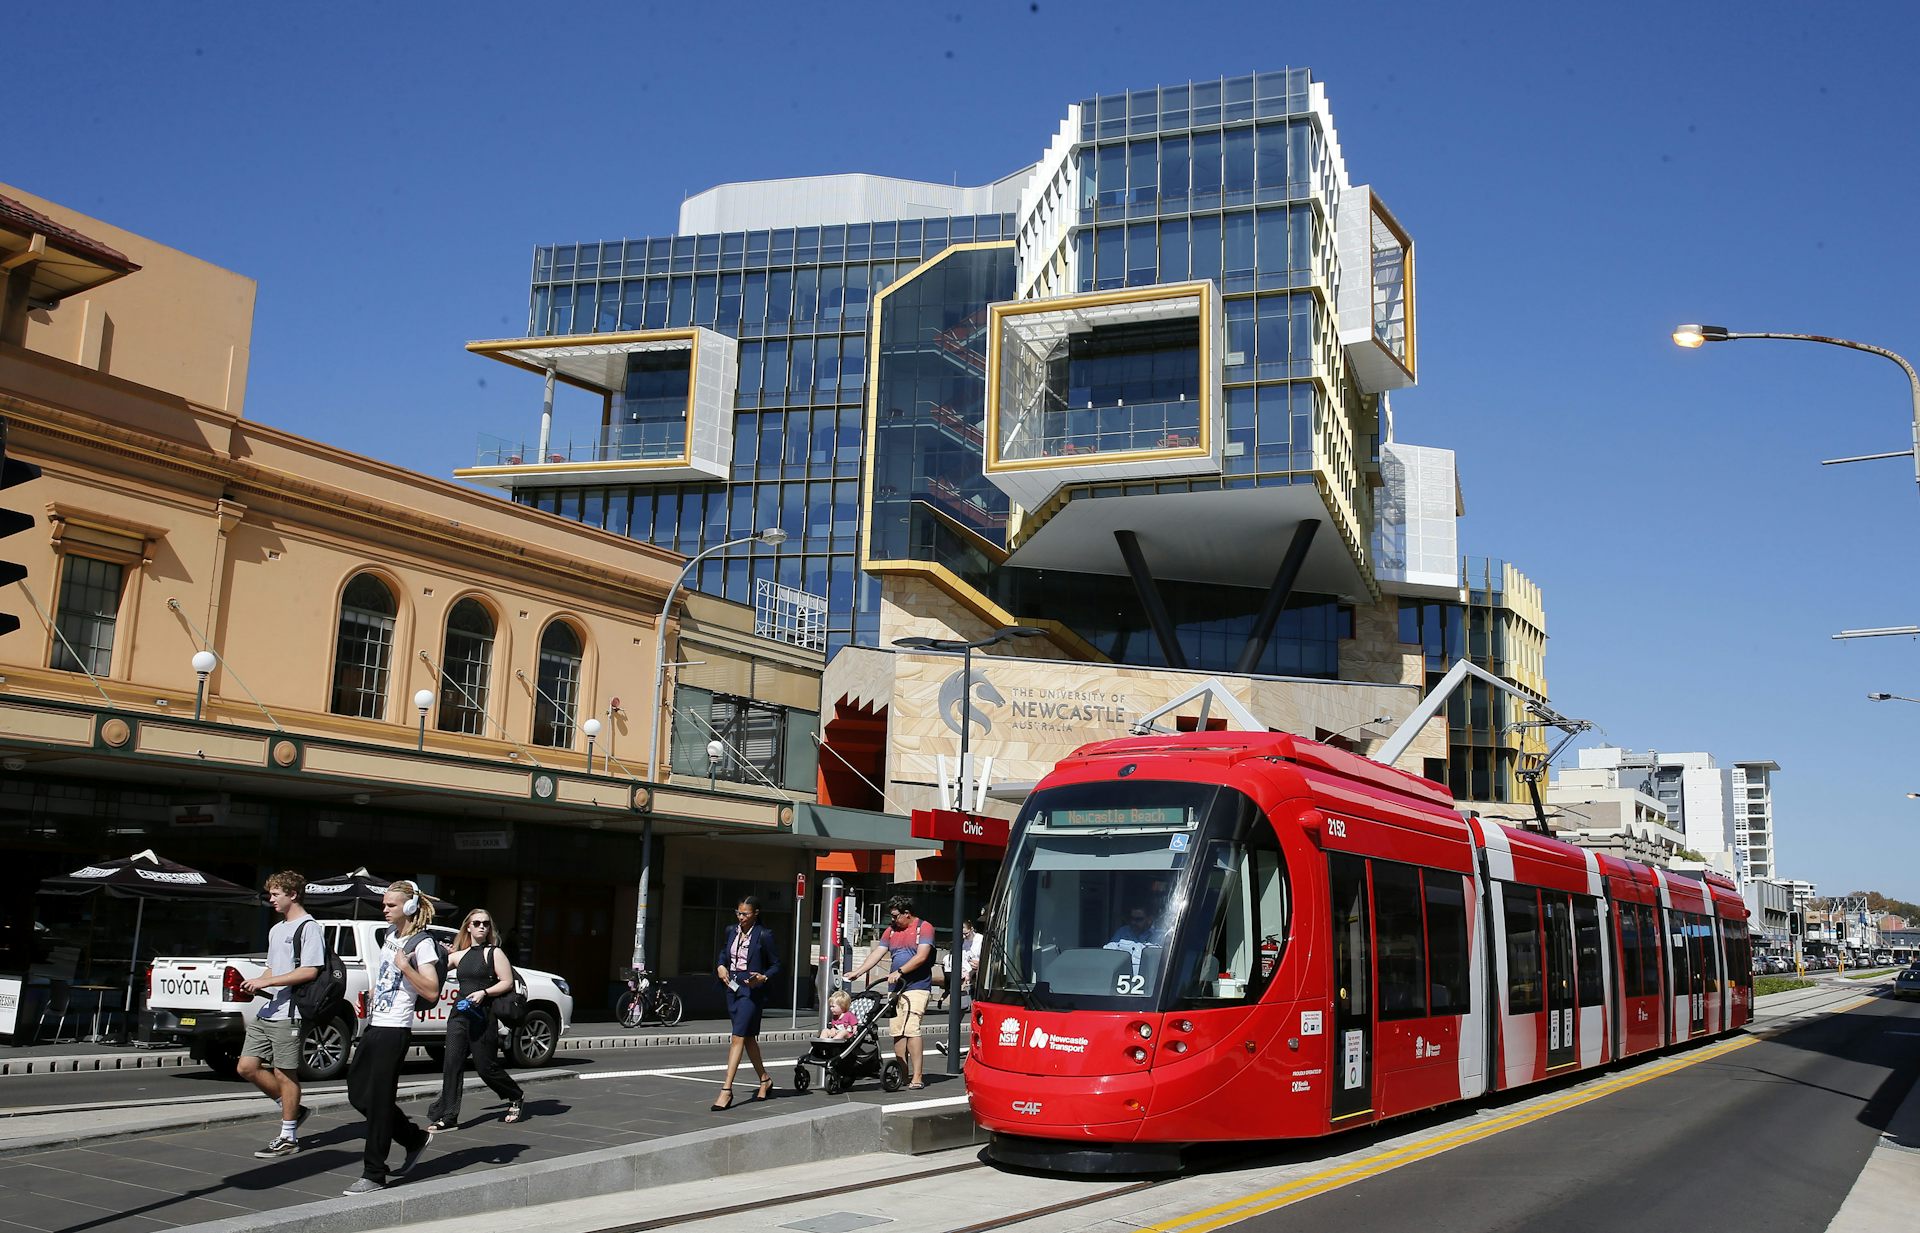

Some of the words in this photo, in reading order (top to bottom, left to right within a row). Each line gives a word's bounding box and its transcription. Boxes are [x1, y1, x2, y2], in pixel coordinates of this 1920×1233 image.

[1012, 688, 1034, 697] THE
[1039, 689, 1106, 701] UNIVERSITY
[1111, 694, 1126, 703] OF
[1012, 701, 1125, 723] NEWCASTLE
[1012, 721, 1073, 732] AUSTRALIA
[1068, 809, 1125, 824] Newcastle
[1131, 808, 1165, 823] Beach
[963, 820, 983, 836] Civic
[1327, 817, 1347, 838] 2152
[160, 979, 210, 995] TOYOTA
[1116, 974, 1145, 995] 52
[999, 1033, 1019, 1043] NSW
[1049, 1034, 1089, 1045] Newcastle
[1049, 1042, 1085, 1053] Transport
[1012, 1101, 1043, 1115] CAF
